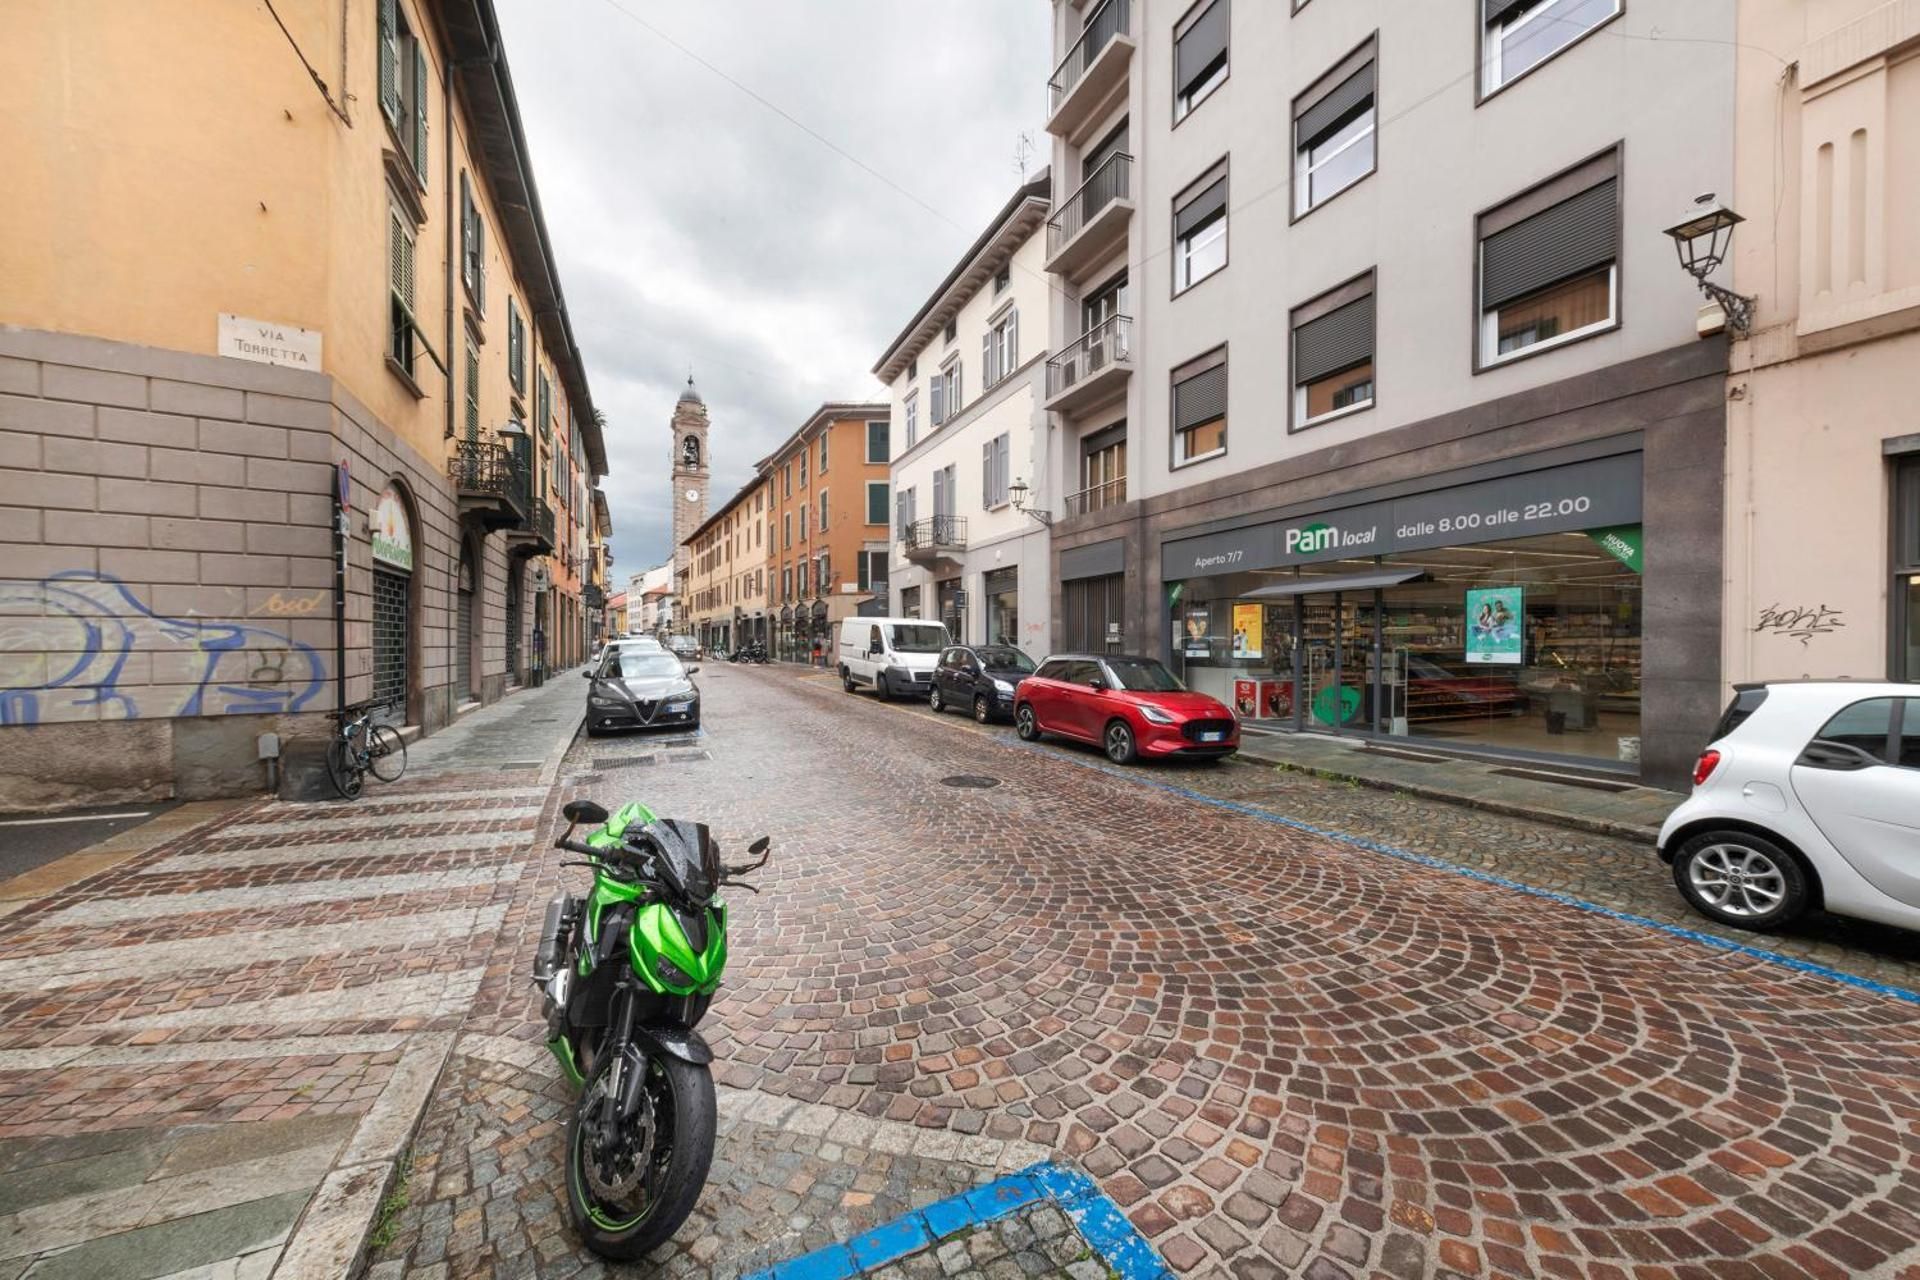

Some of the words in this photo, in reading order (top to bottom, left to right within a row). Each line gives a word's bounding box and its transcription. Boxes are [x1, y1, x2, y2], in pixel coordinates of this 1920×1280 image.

[258, 328, 285, 341] VIA
[233, 338, 308, 363] TORRETTA
[1396, 522, 1435, 538] dalle
[1438, 513, 1480, 532] 8.00
[1485, 509, 1519, 525] alle
[1523, 496, 1590, 521] 22.00
[1285, 526, 1339, 554] Pam
[1342, 526, 1376, 546] local
[1606, 533, 1635, 557] NUOVA
[1195, 555, 1225, 568] Aperto
[1227, 550, 1243, 564] 7/7
